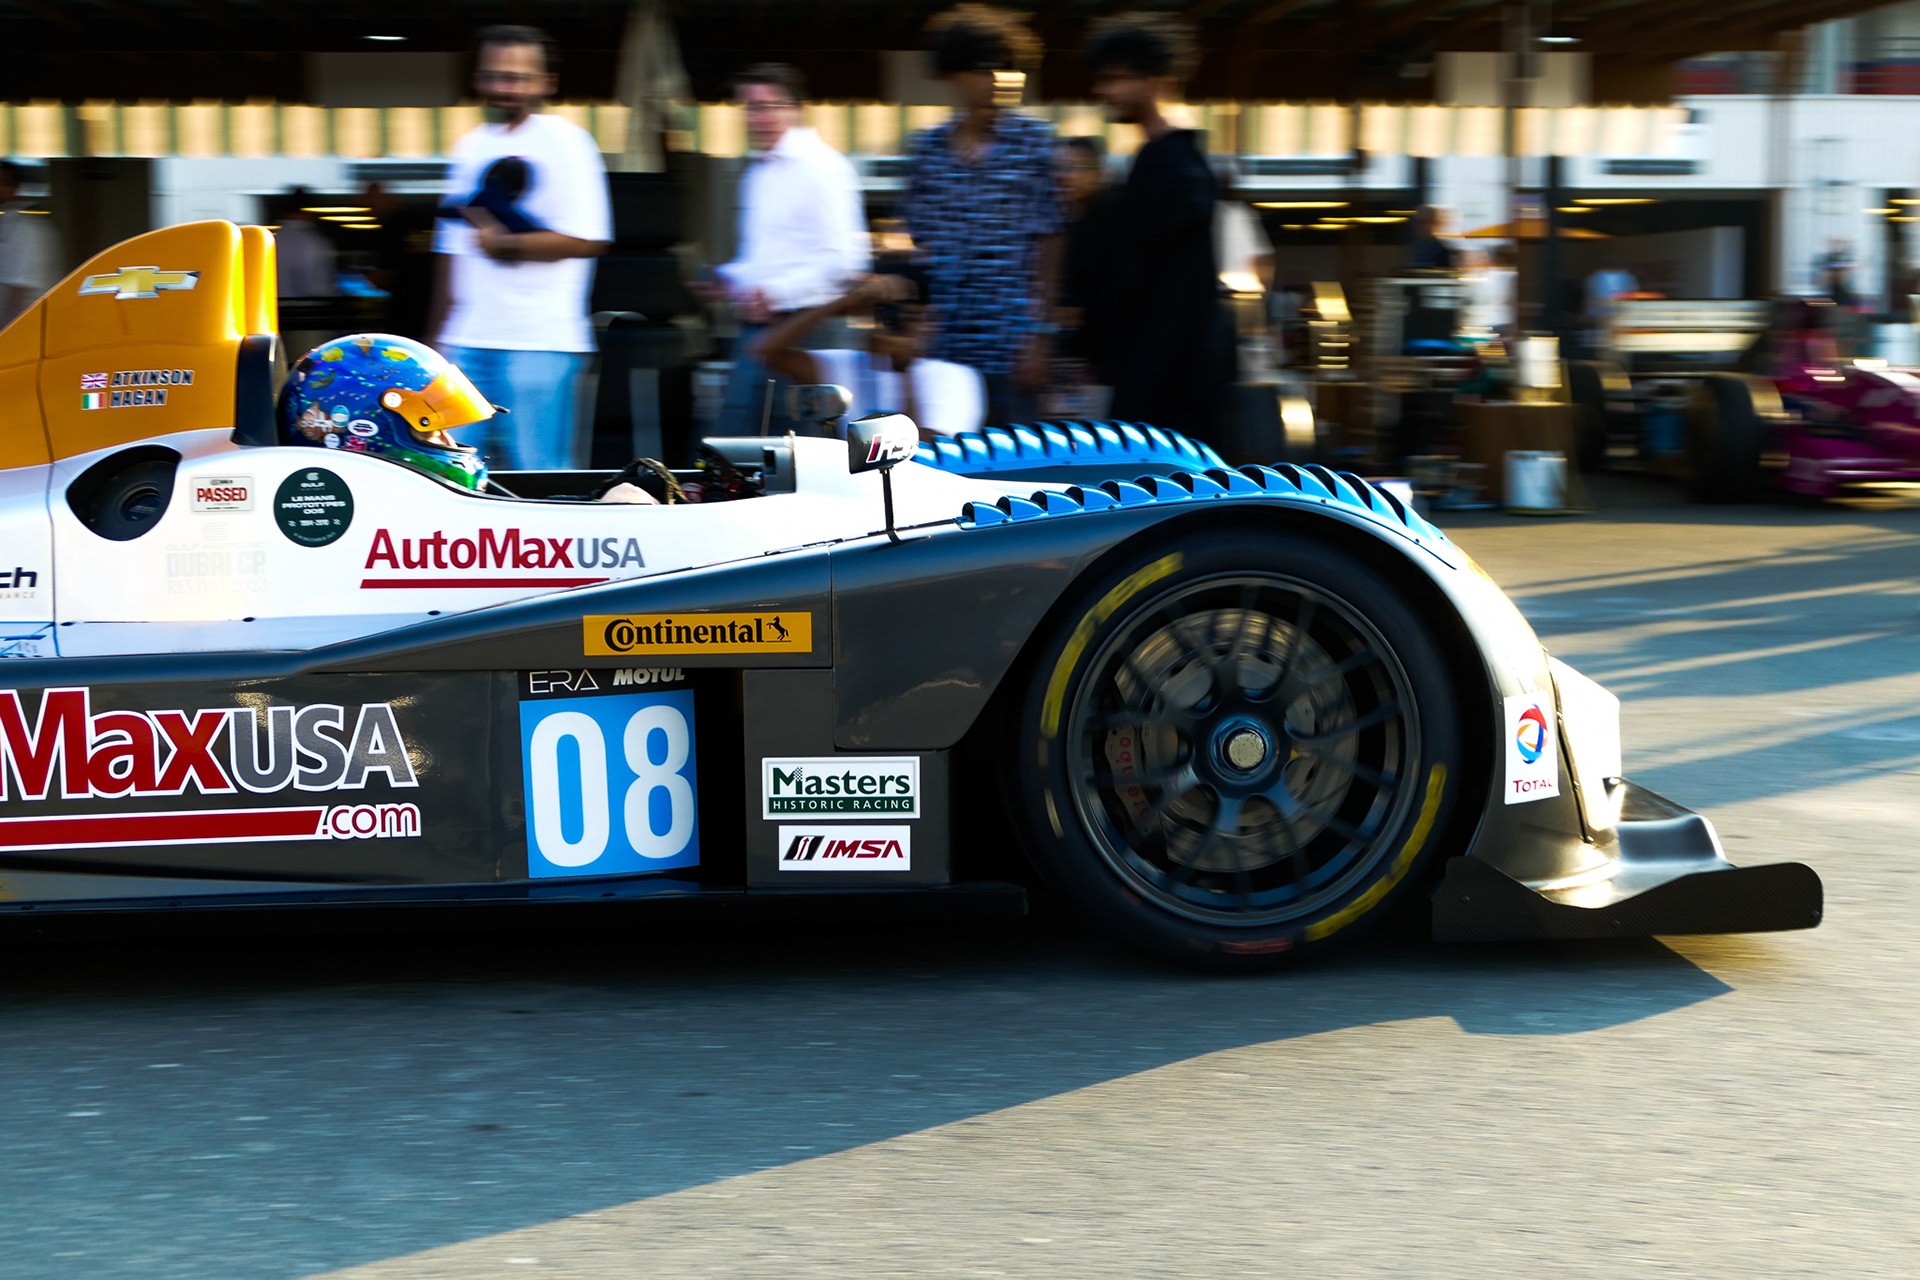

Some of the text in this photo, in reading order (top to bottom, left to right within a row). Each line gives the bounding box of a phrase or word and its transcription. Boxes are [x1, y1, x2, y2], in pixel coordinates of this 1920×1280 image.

[110, 369, 194, 387] ATKINSON
[197, 487, 248, 502] PASSED
[281, 501, 346, 509] PROTOTYPES
[364, 528, 646, 569] AutoMaxUSA
[166, 551, 232, 578] DUBAI
[604, 617, 765, 652] Continental
[529, 667, 685, 694] ERA MOTUL
[530, 704, 695, 868] 08
[772, 766, 911, 796] Masters
[1512, 779, 1554, 794] TOTAL
[773, 799, 910, 810] HISTORIC RACING
[318, 803, 421, 840] .com
[821, 839, 904, 859] IMSA
